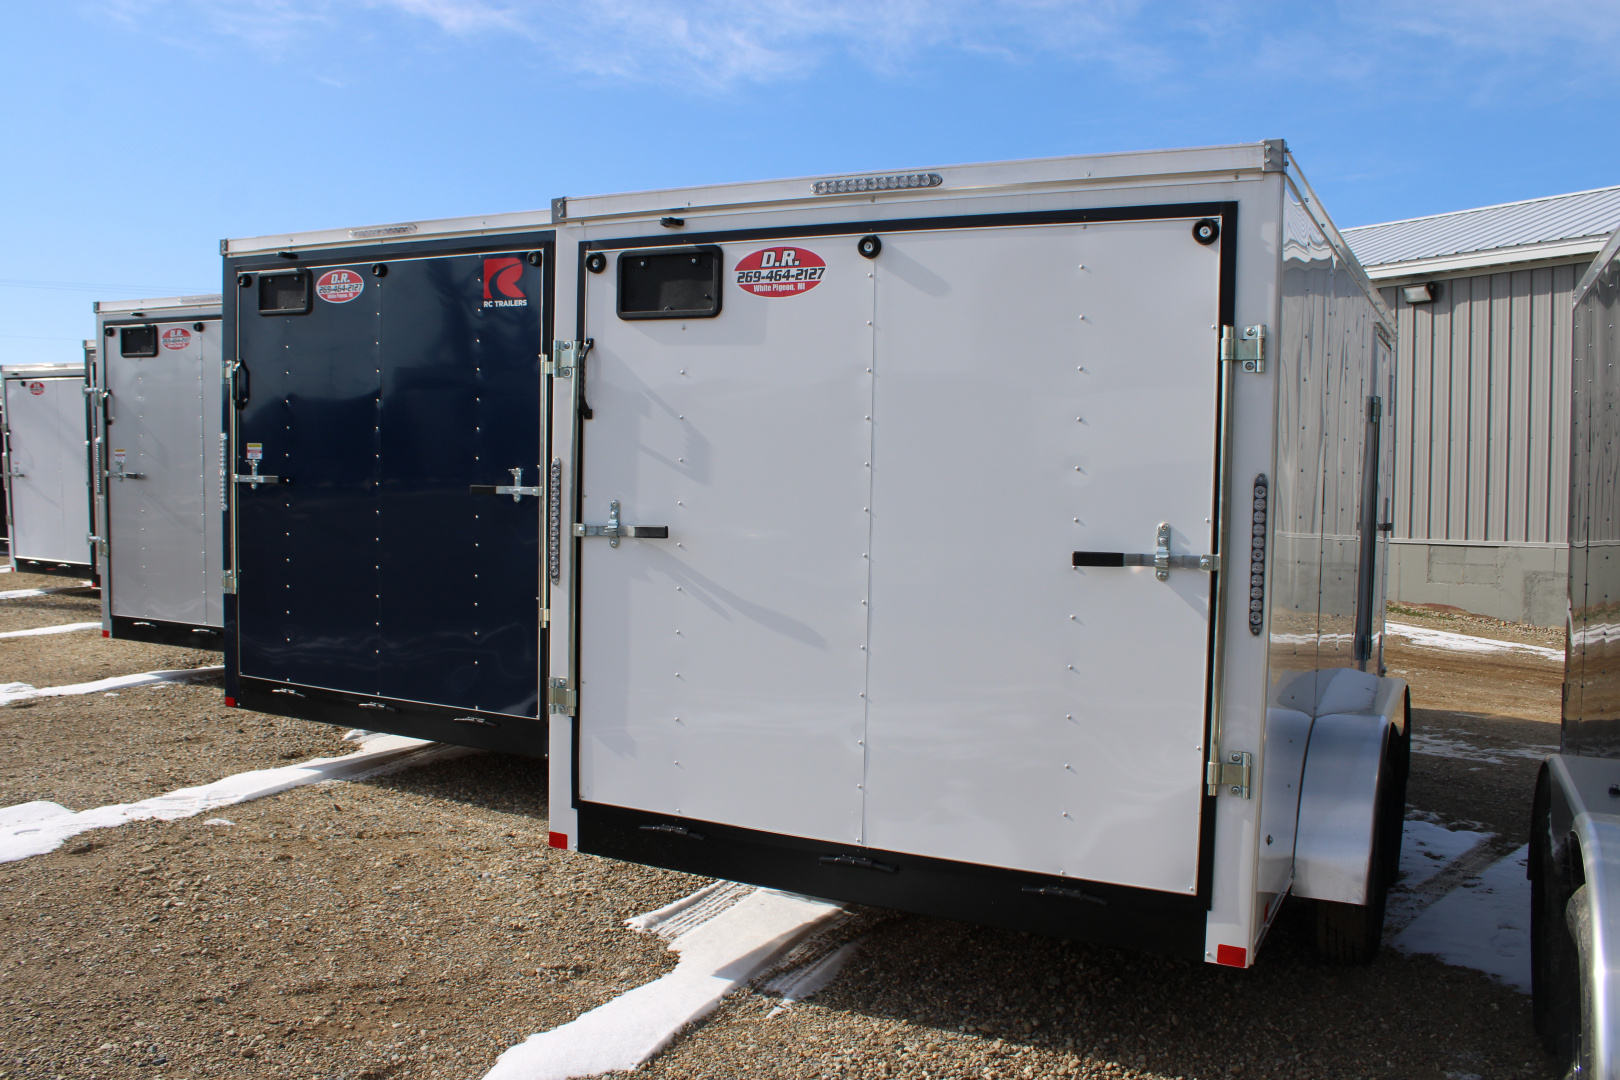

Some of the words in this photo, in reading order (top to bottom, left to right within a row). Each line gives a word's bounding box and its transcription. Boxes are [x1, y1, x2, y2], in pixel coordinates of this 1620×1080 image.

[760, 249, 800, 268] D.R.
[330, 272, 351, 284] D.R.
[737, 267, 826, 283] 269-464-2127
[753, 284, 771, 293] White
[483, 300, 494, 308] RC
[494, 299, 528, 307] TRAILERS
